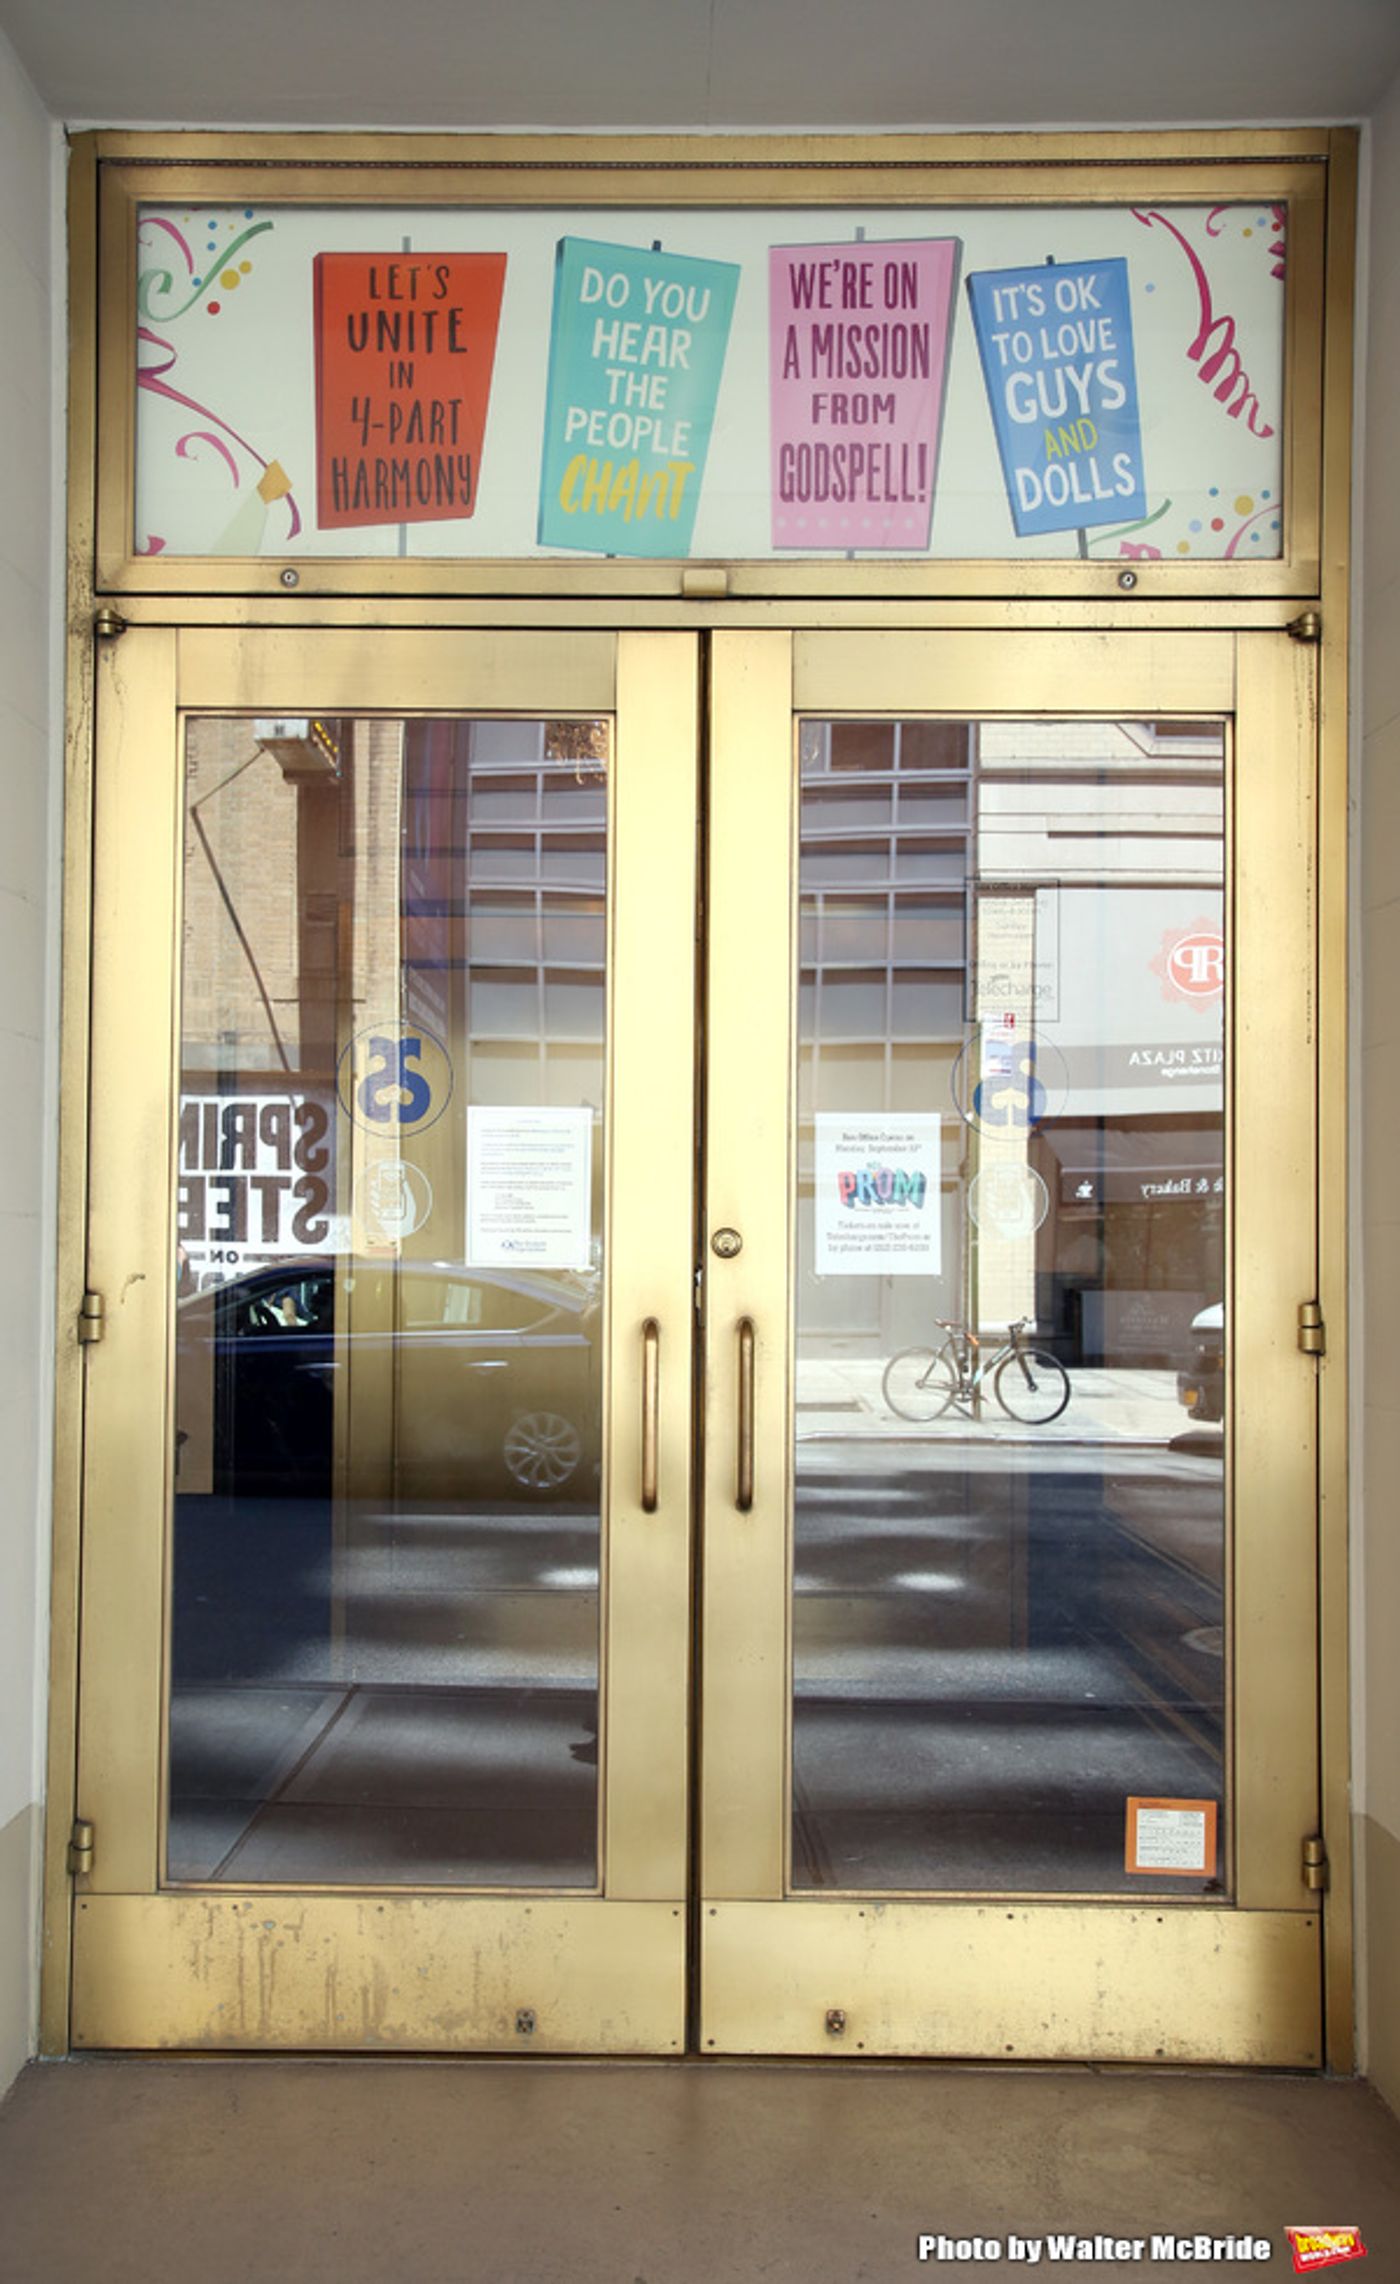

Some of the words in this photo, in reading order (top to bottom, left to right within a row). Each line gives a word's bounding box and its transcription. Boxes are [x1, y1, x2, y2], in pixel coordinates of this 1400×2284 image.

[370, 264, 449, 300] LET'S
[580, 266, 629, 309] DO
[644, 278, 711, 322] YOU
[789, 259, 873, 310] WE'RE
[884, 262, 918, 310] ON
[991, 282, 1045, 323] IT'S
[1055, 275, 1101, 312] OK
[347, 307, 467, 353] UNITE
[591, 318, 692, 369] HEAR
[783, 325, 800, 379] A
[811, 323, 930, 379] MISSION
[991, 329, 1034, 365] TO
[1040, 318, 1117, 358] LOVE
[390, 361, 413, 389] IN
[605, 368, 669, 410] THE
[1005, 358, 1127, 424] GUYS
[351, 397, 462, 446] 4-PART
[565, 406, 692, 457] PEOPLE
[812, 393, 895, 424] FROM
[1045, 419, 1098, 462] AND
[331, 454, 471, 512] HARMONY
[559, 454, 695, 524] CHANT
[779, 443, 928, 503] GODSPELL!
[1014, 452, 1136, 512] DOLLS
[837, 1166, 927, 1210] PROM
